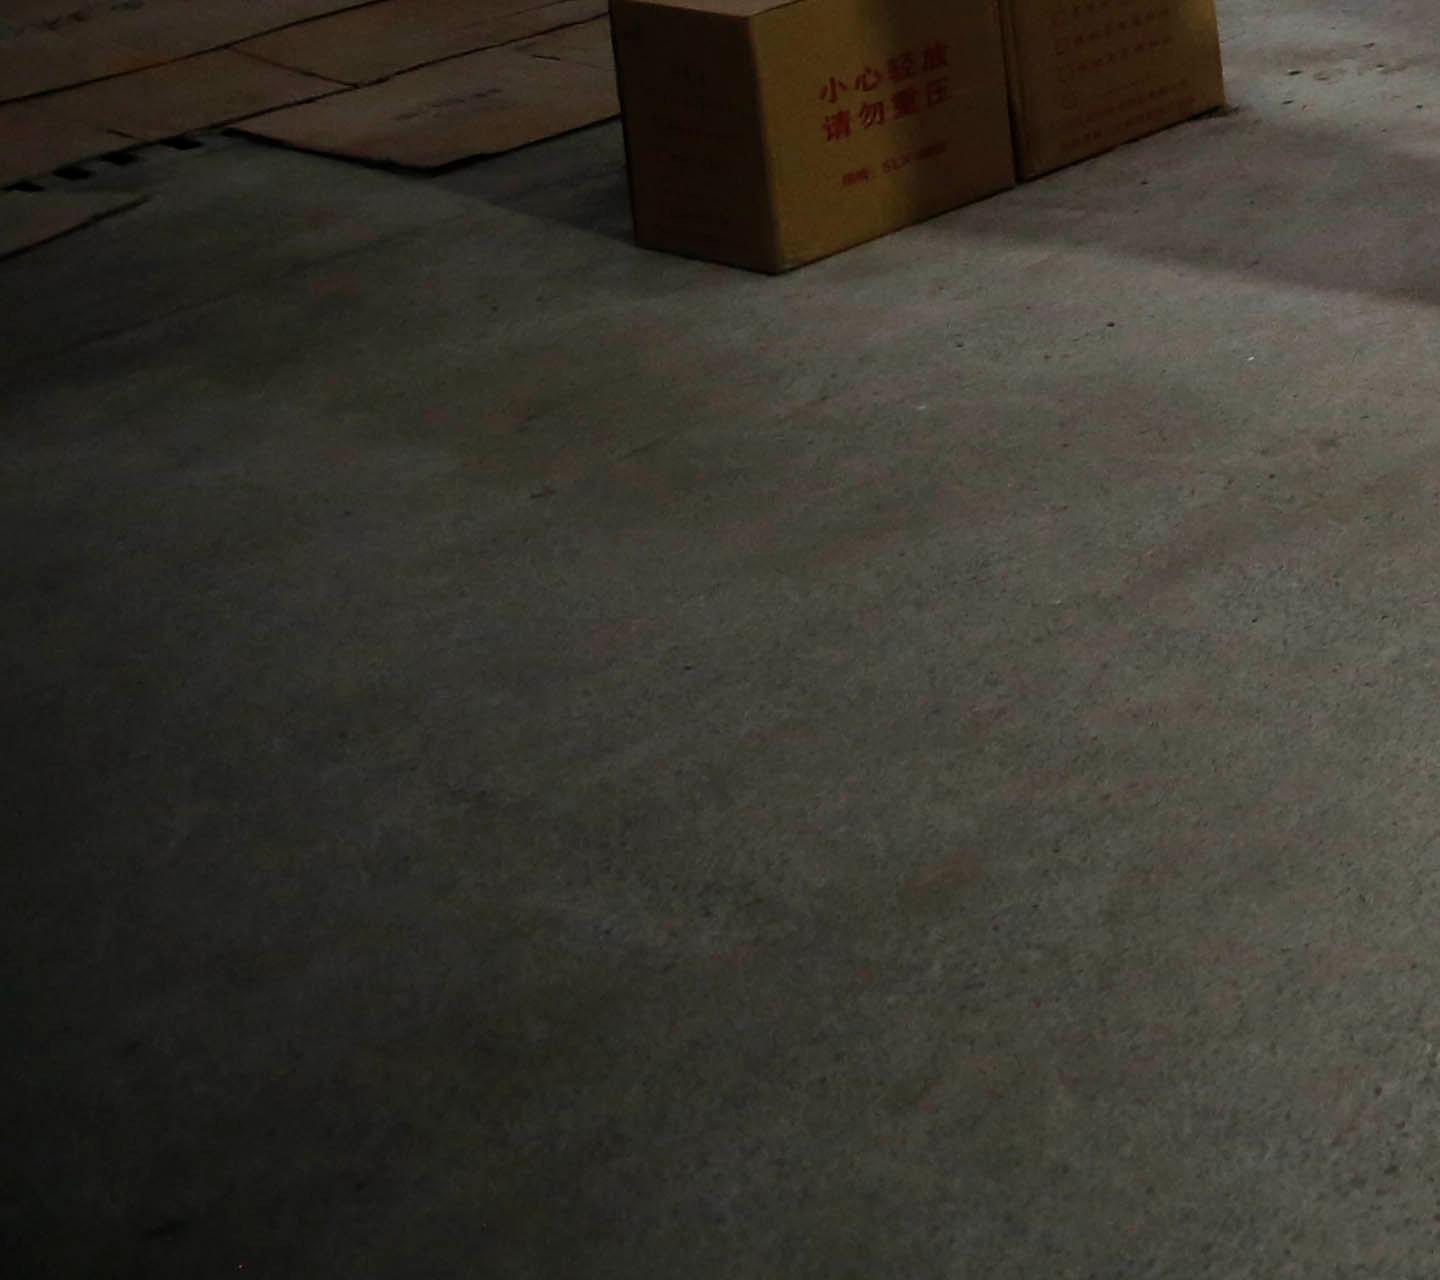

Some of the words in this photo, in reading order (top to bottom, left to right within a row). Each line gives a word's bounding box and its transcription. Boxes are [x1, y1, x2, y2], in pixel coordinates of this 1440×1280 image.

[818, 41, 950, 104] 小心轻放
[821, 74, 953, 142] 请勿重压
